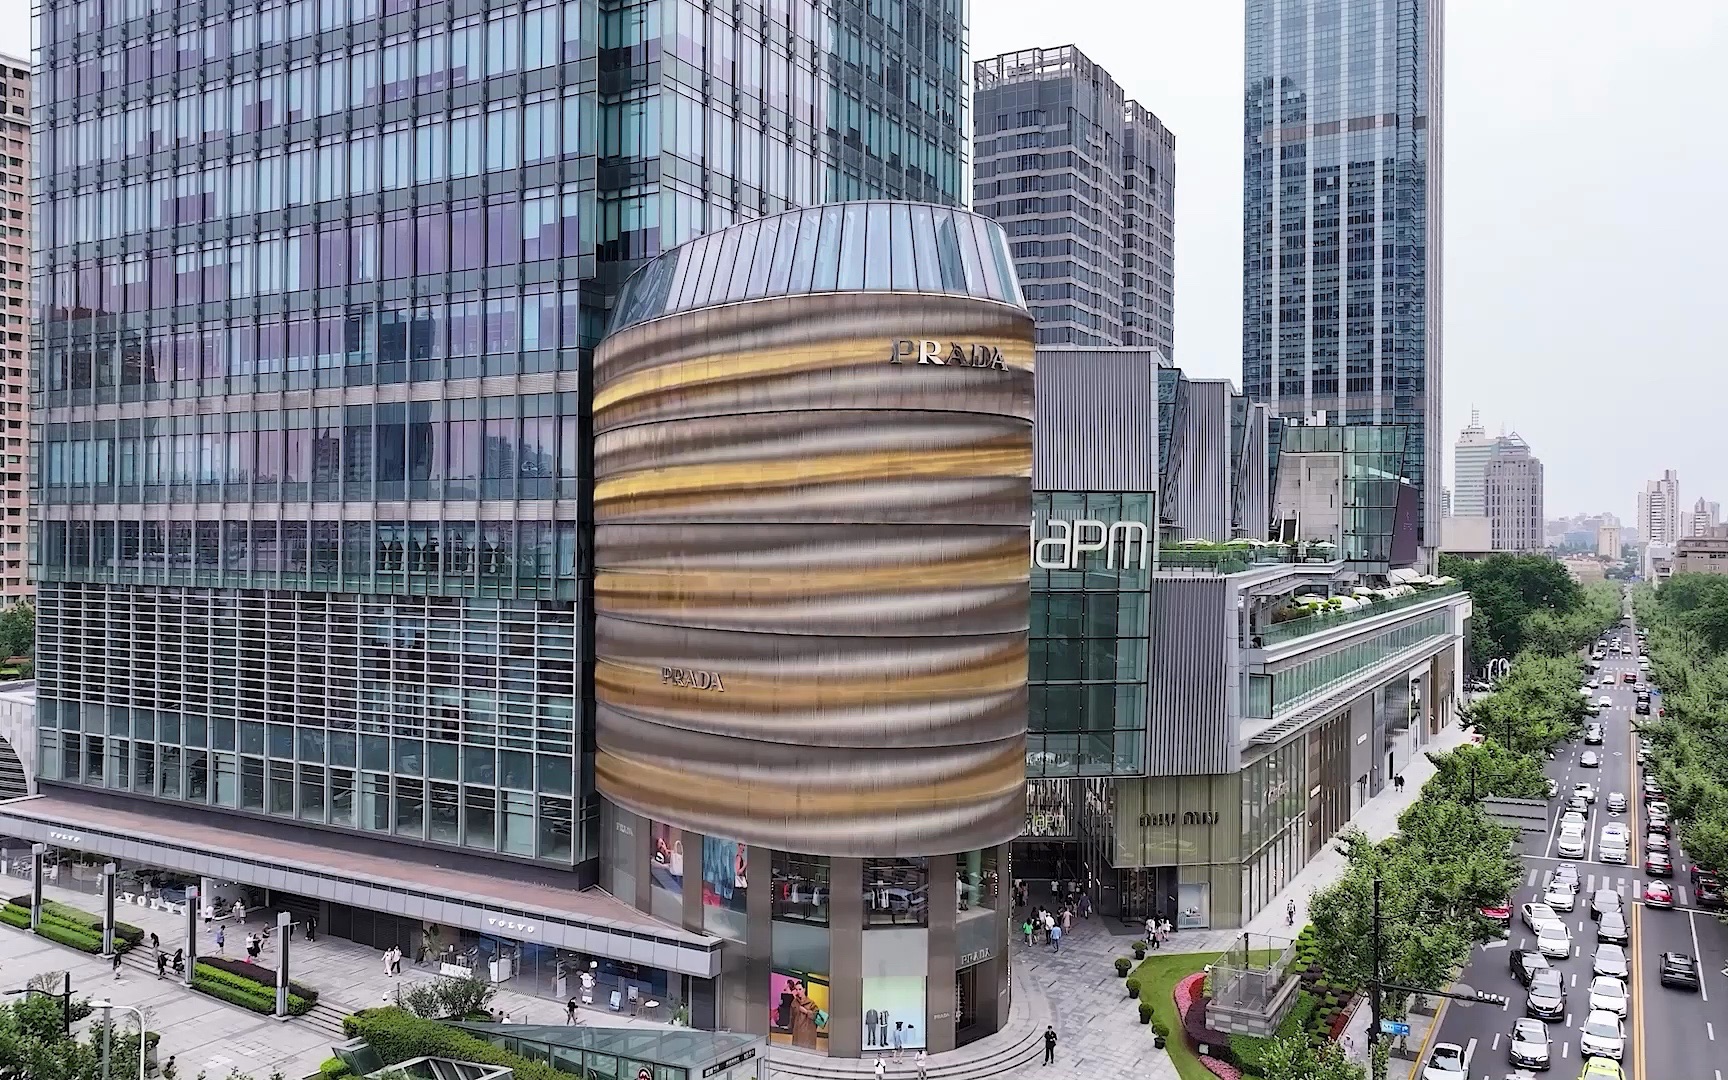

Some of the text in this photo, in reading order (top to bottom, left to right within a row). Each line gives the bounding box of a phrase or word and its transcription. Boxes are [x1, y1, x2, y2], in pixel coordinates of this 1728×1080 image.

[890, 339, 1009, 372] PRADA
[661, 666, 725, 693] PRADA
[1139, 811, 1219, 827] miu miu
[50, 831, 81, 842] VOLVO
[488, 918, 535, 933] VOLVO
[961, 947, 991, 965] PRADA
